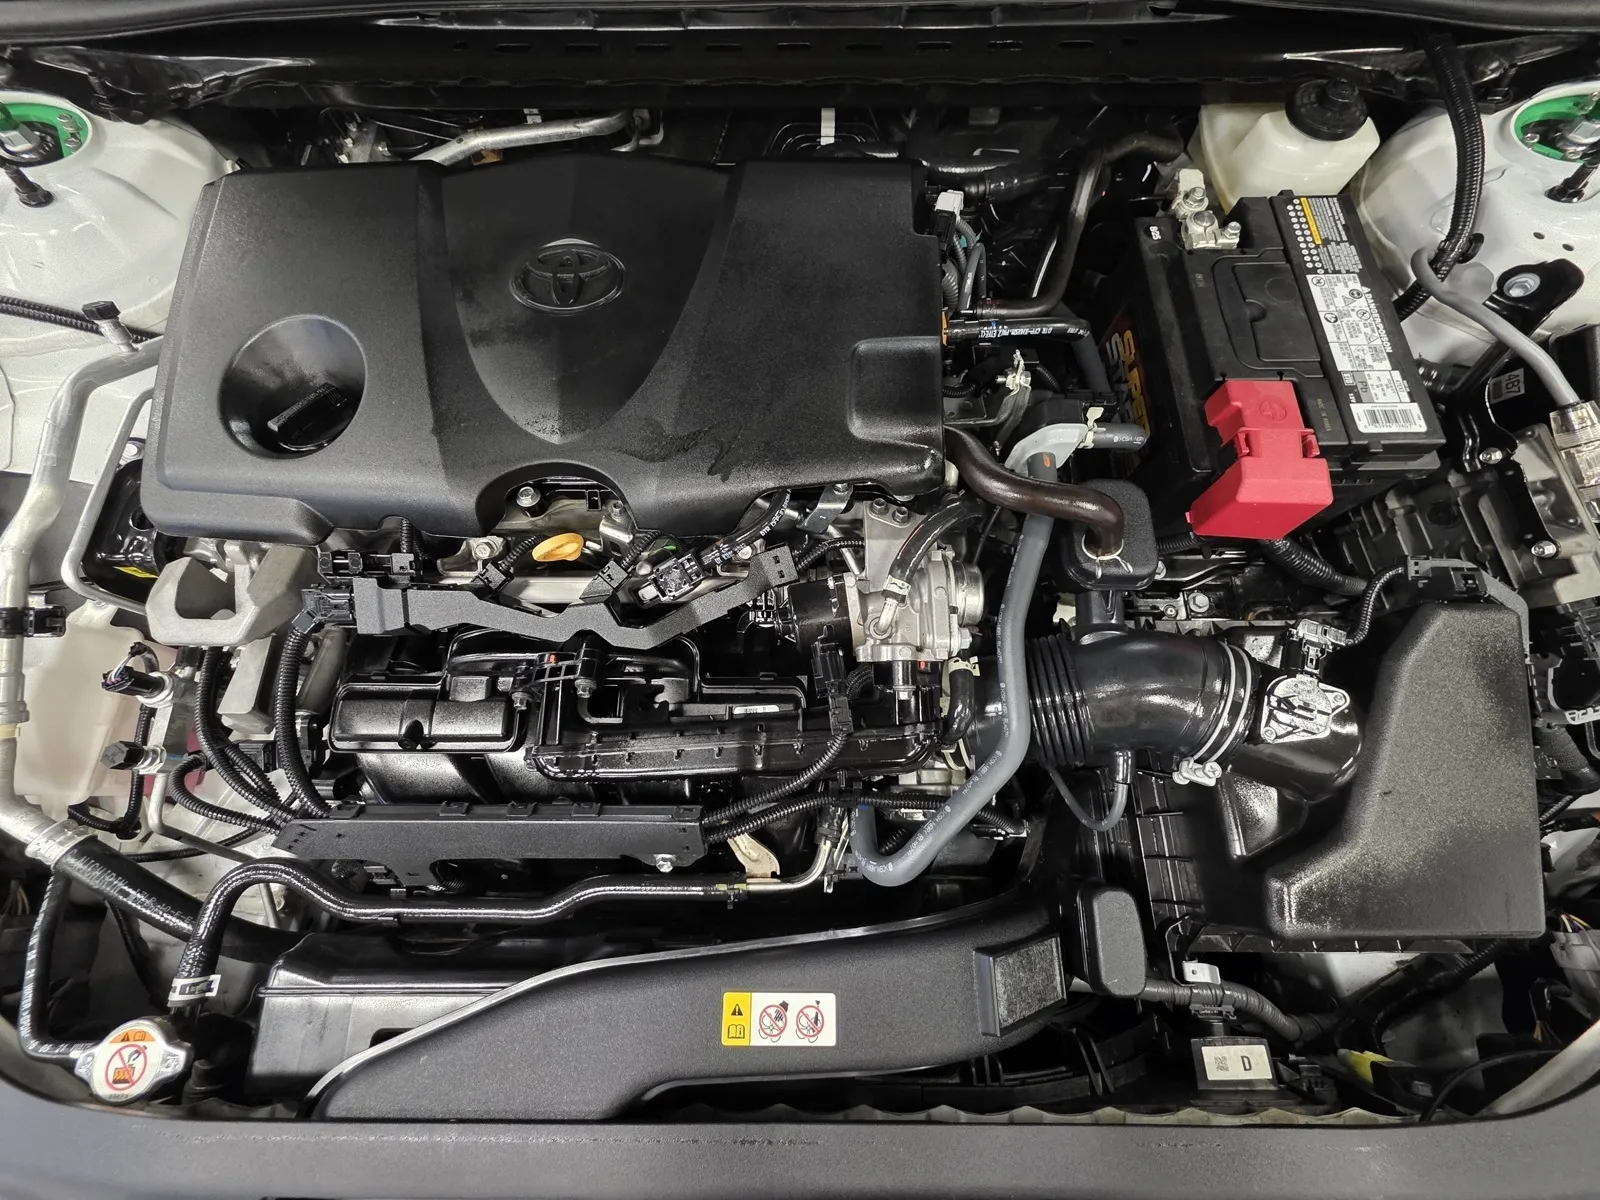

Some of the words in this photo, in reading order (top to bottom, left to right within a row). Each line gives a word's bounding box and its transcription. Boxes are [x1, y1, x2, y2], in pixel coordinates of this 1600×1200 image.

[1357, 381, 1368, 393] Pb
[1505, 374, 1520, 393] 4B7
[1240, 1055, 1252, 1072] D
